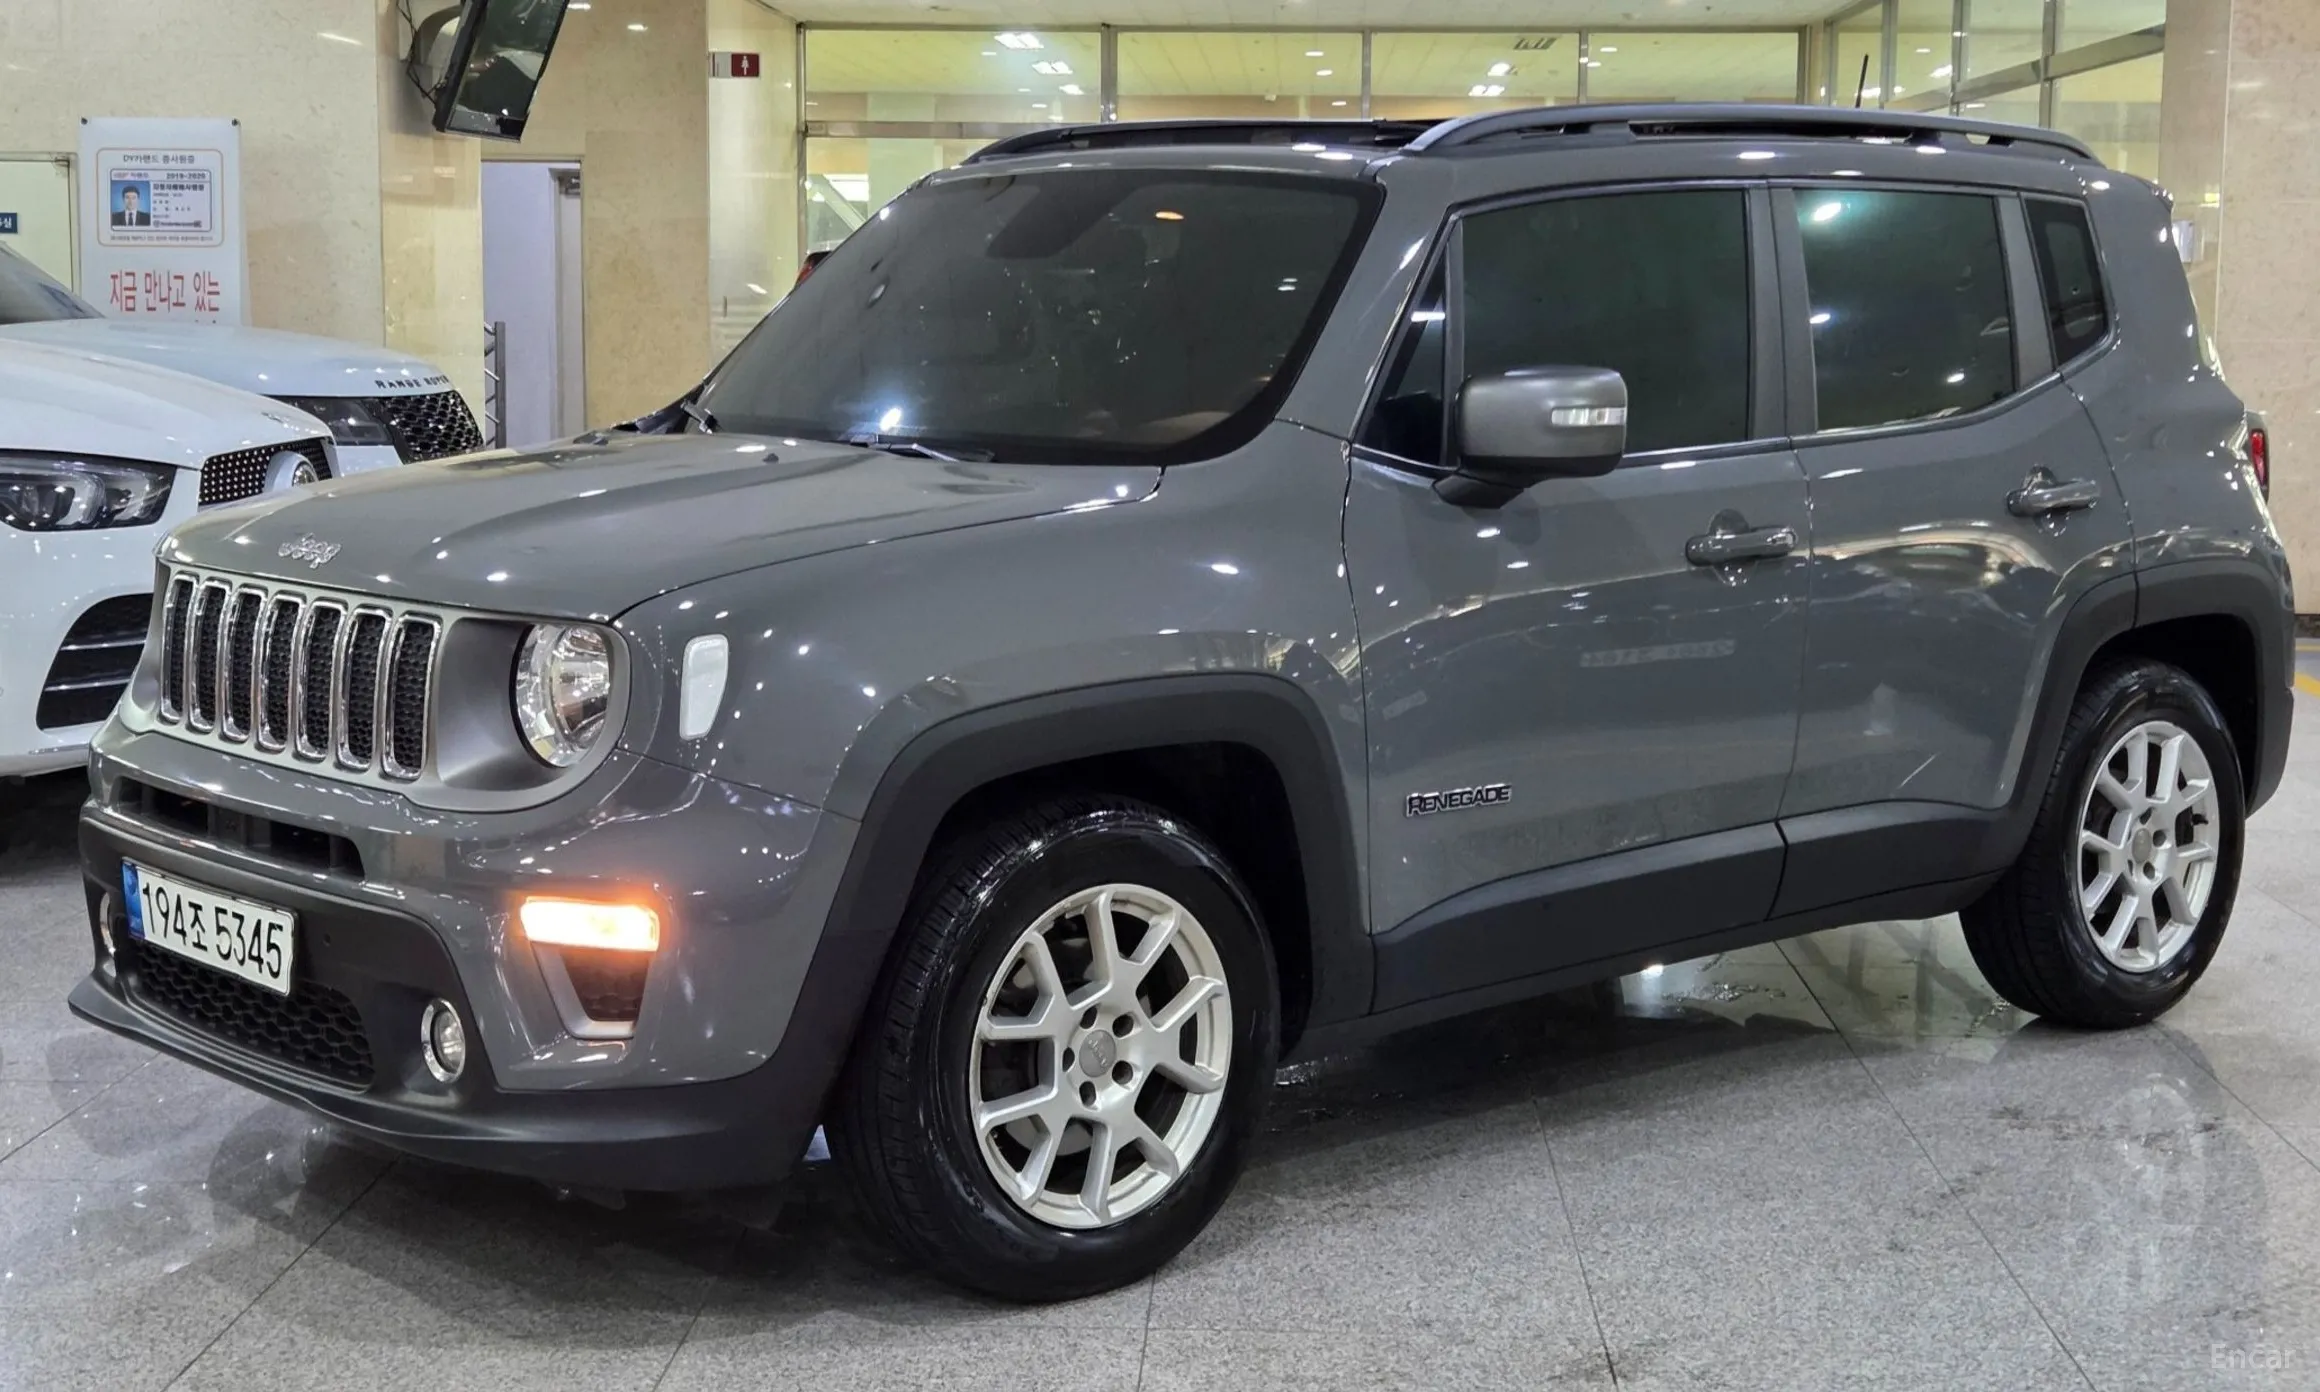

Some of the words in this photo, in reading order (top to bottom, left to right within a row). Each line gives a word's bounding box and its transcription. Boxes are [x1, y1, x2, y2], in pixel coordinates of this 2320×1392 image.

[110, 269, 137, 312] 지금
[144, 269, 186, 313] 만나고
[193, 269, 220, 312] 있는
[374, 379, 421, 389] RANGE
[278, 531, 341, 569] Jeep
[1406, 783, 1512, 817] RENEGADE
[142, 882, 208, 952] 194조
[214, 906, 284, 979] 5345
